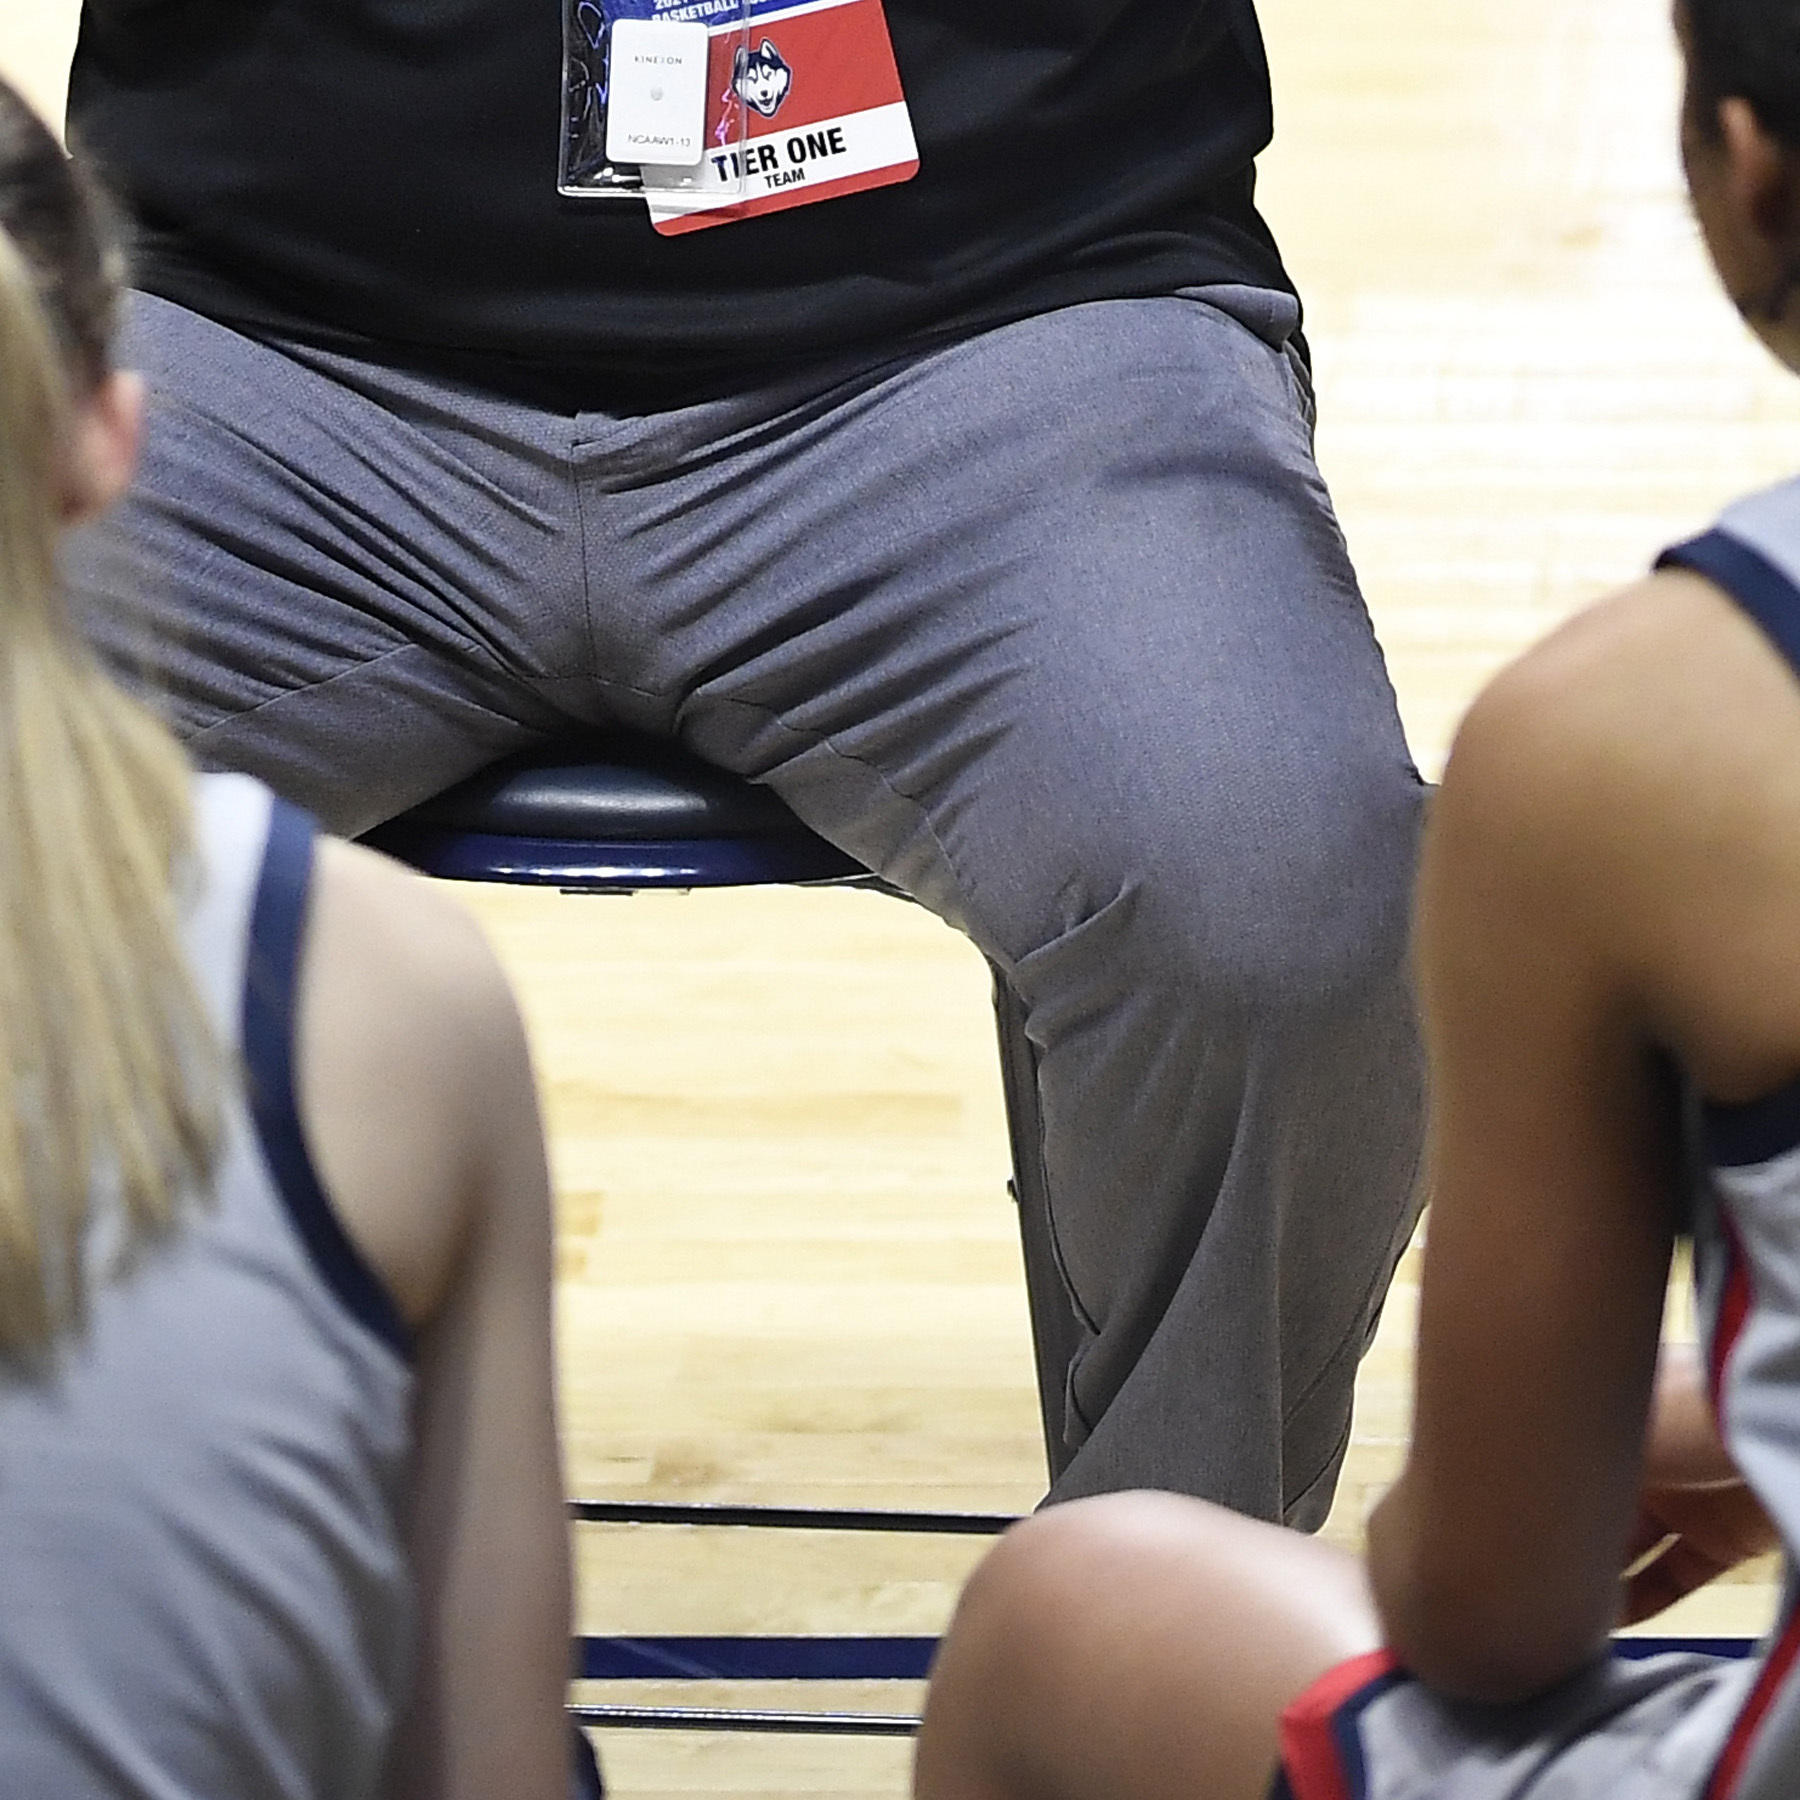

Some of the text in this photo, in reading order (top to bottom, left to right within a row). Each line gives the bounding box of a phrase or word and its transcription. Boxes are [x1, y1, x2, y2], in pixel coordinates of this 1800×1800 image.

[711, 126, 847, 182] TIER ONE
[764, 167, 806, 189] TEAM
